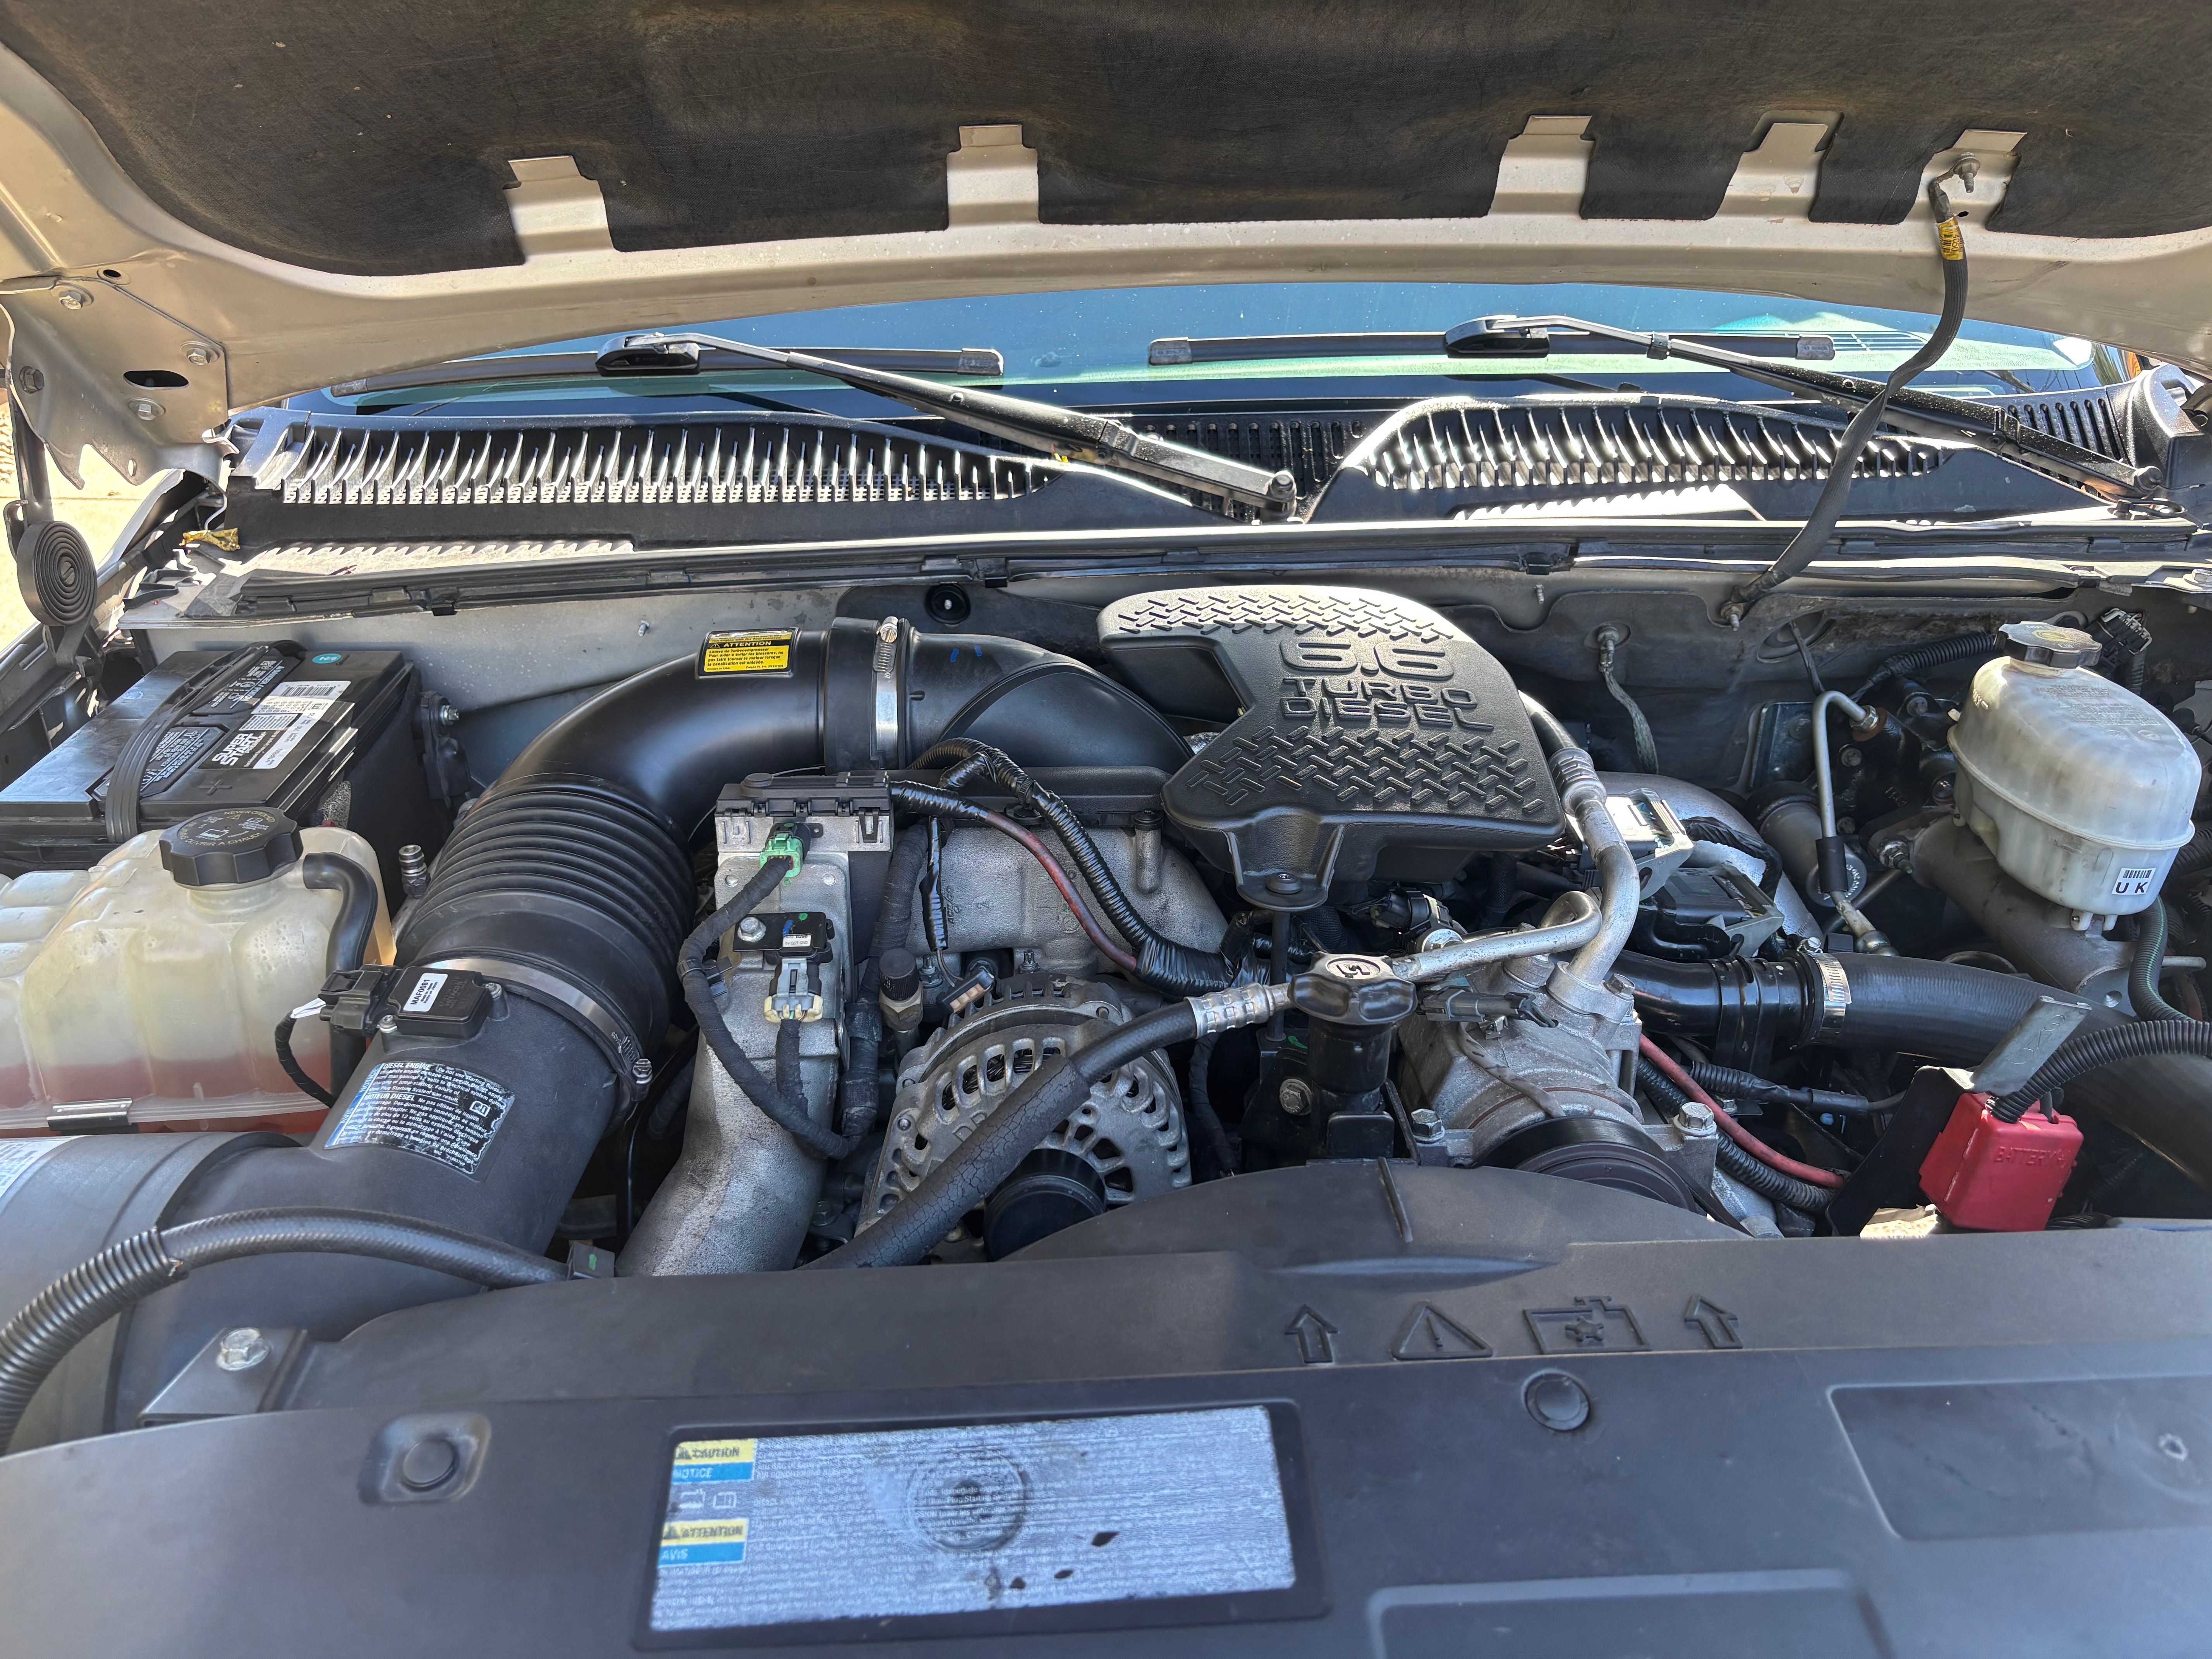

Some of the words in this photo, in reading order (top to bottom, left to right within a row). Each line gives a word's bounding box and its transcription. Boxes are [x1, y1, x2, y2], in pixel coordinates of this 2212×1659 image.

[1951, 234, 1960, 251] 4050
[1279, 637, 1454, 681] 6.6
[1283, 677, 1477, 708] TURBO
[1281, 696, 1494, 730] DIESEL
[212, 733, 249, 762] SUPER
[220, 733, 258, 766] START
[228, 833, 263, 844] CHAUD!
[410, 979, 430, 1005] MAF0081
[358, 1068, 379, 1093] NOTICE
[405, 1062, 432, 1070] ENGINE
[465, 1075, 486, 1086] starting
[442, 1095, 459, 1103] result.
[471, 1090, 488, 1100] system
[488, 1091, 503, 1101] apply
[404, 1101, 433, 1111] dommages
[433, 1108, 461, 1120] immédiats
[469, 1122, 487, 1133] moteur
[436, 1103, 455, 1111] utiliser
[462, 1111, 479, 1121] liquide
[406, 1121, 434, 1132] démarrage
[440, 1130, 455, 1139] l'aide
[429, 1114, 454, 1125] appliquer
[465, 1127, 484, 1139] tension
[431, 1121, 453, 1131] système
[453, 1129, 479, 1144] électrique
[692, 1447, 740, 1458] CAUTION
[672, 1467, 713, 1478] NOTICE
[681, 1526, 743, 1537] ATTENTION
[661, 1549, 688, 1561] AVIS
